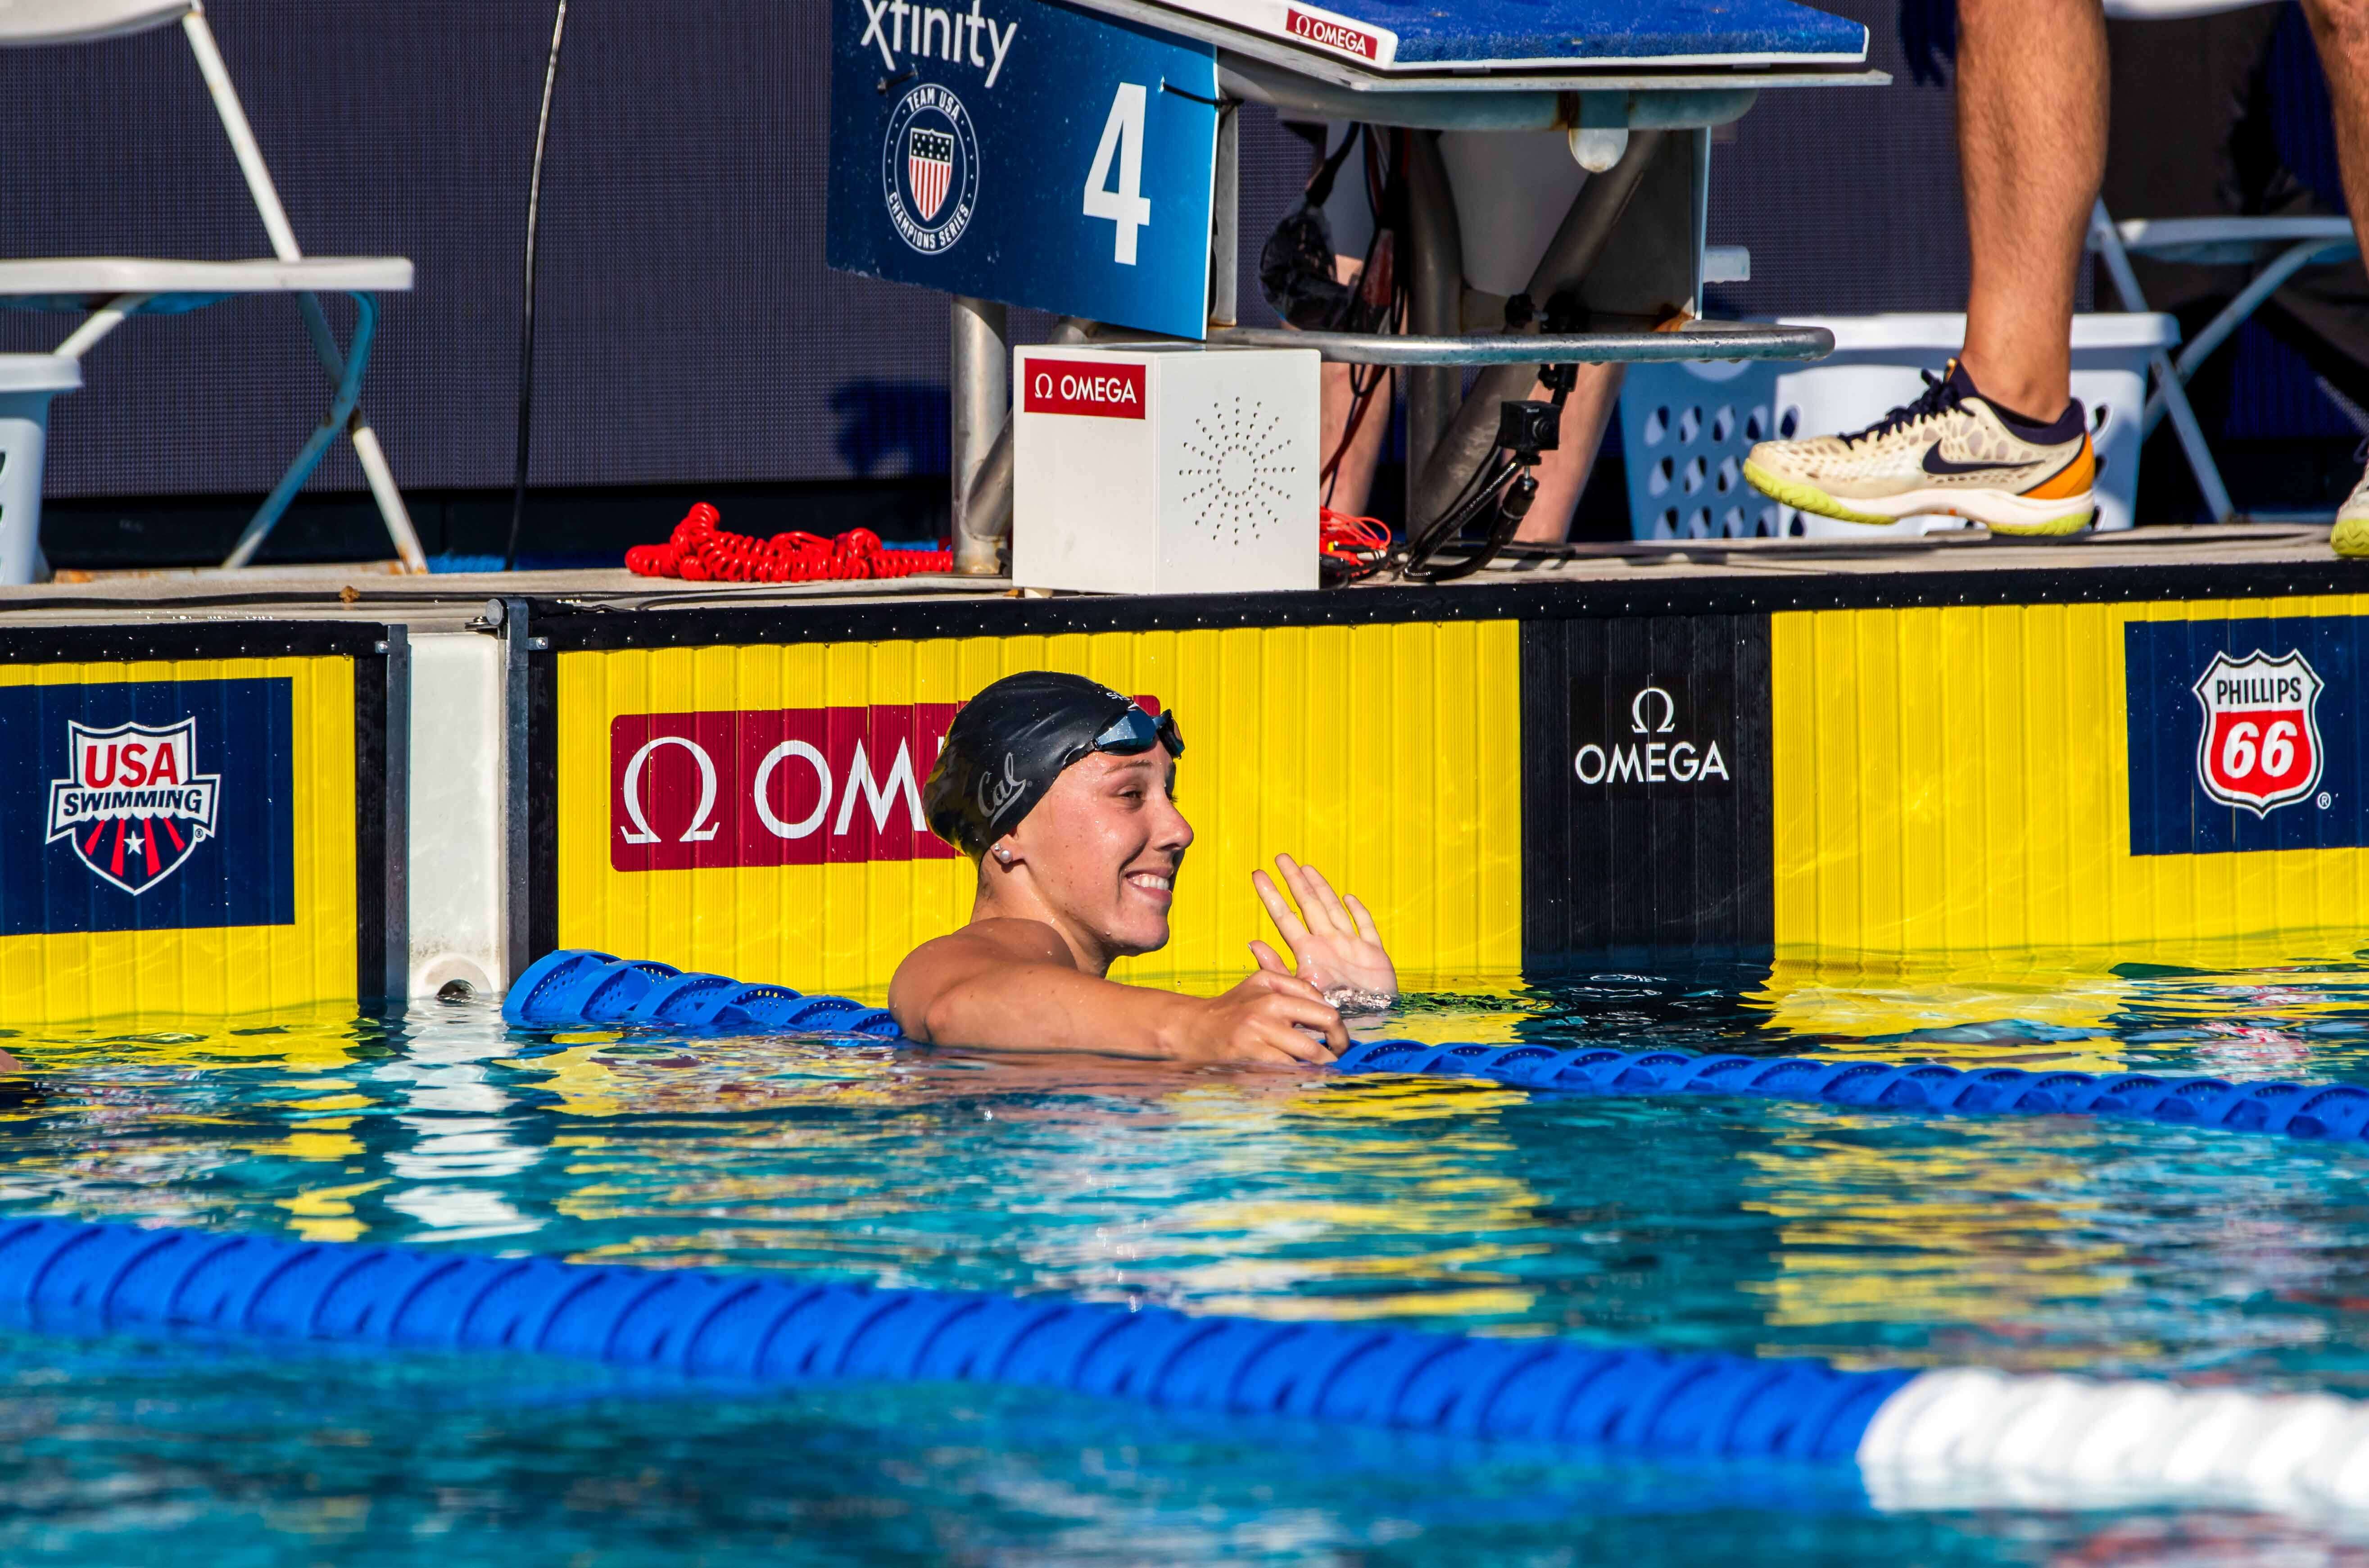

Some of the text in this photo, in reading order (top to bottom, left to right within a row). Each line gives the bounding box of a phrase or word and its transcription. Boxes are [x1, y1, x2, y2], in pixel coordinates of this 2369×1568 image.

[861, 0, 1018, 88] xfinity
[1313, 22, 1367, 55] OMEGA
[906, 88, 960, 121] TEAM USA
[1083, 82, 1151, 266] 4
[888, 192, 969, 249] CHAMPIONS SERIES
[1060, 375, 1137, 403] OMEGA
[2217, 677, 2302, 704] PHILLIPS
[85, 742, 179, 789] USA
[1575, 740, 1730, 784] OMEGA
[2222, 720, 2298, 779] 66
[63, 789, 203, 816] SWIMMING
[754, 735, 945, 839] OM
[978, 752, 1026, 828] Cal
